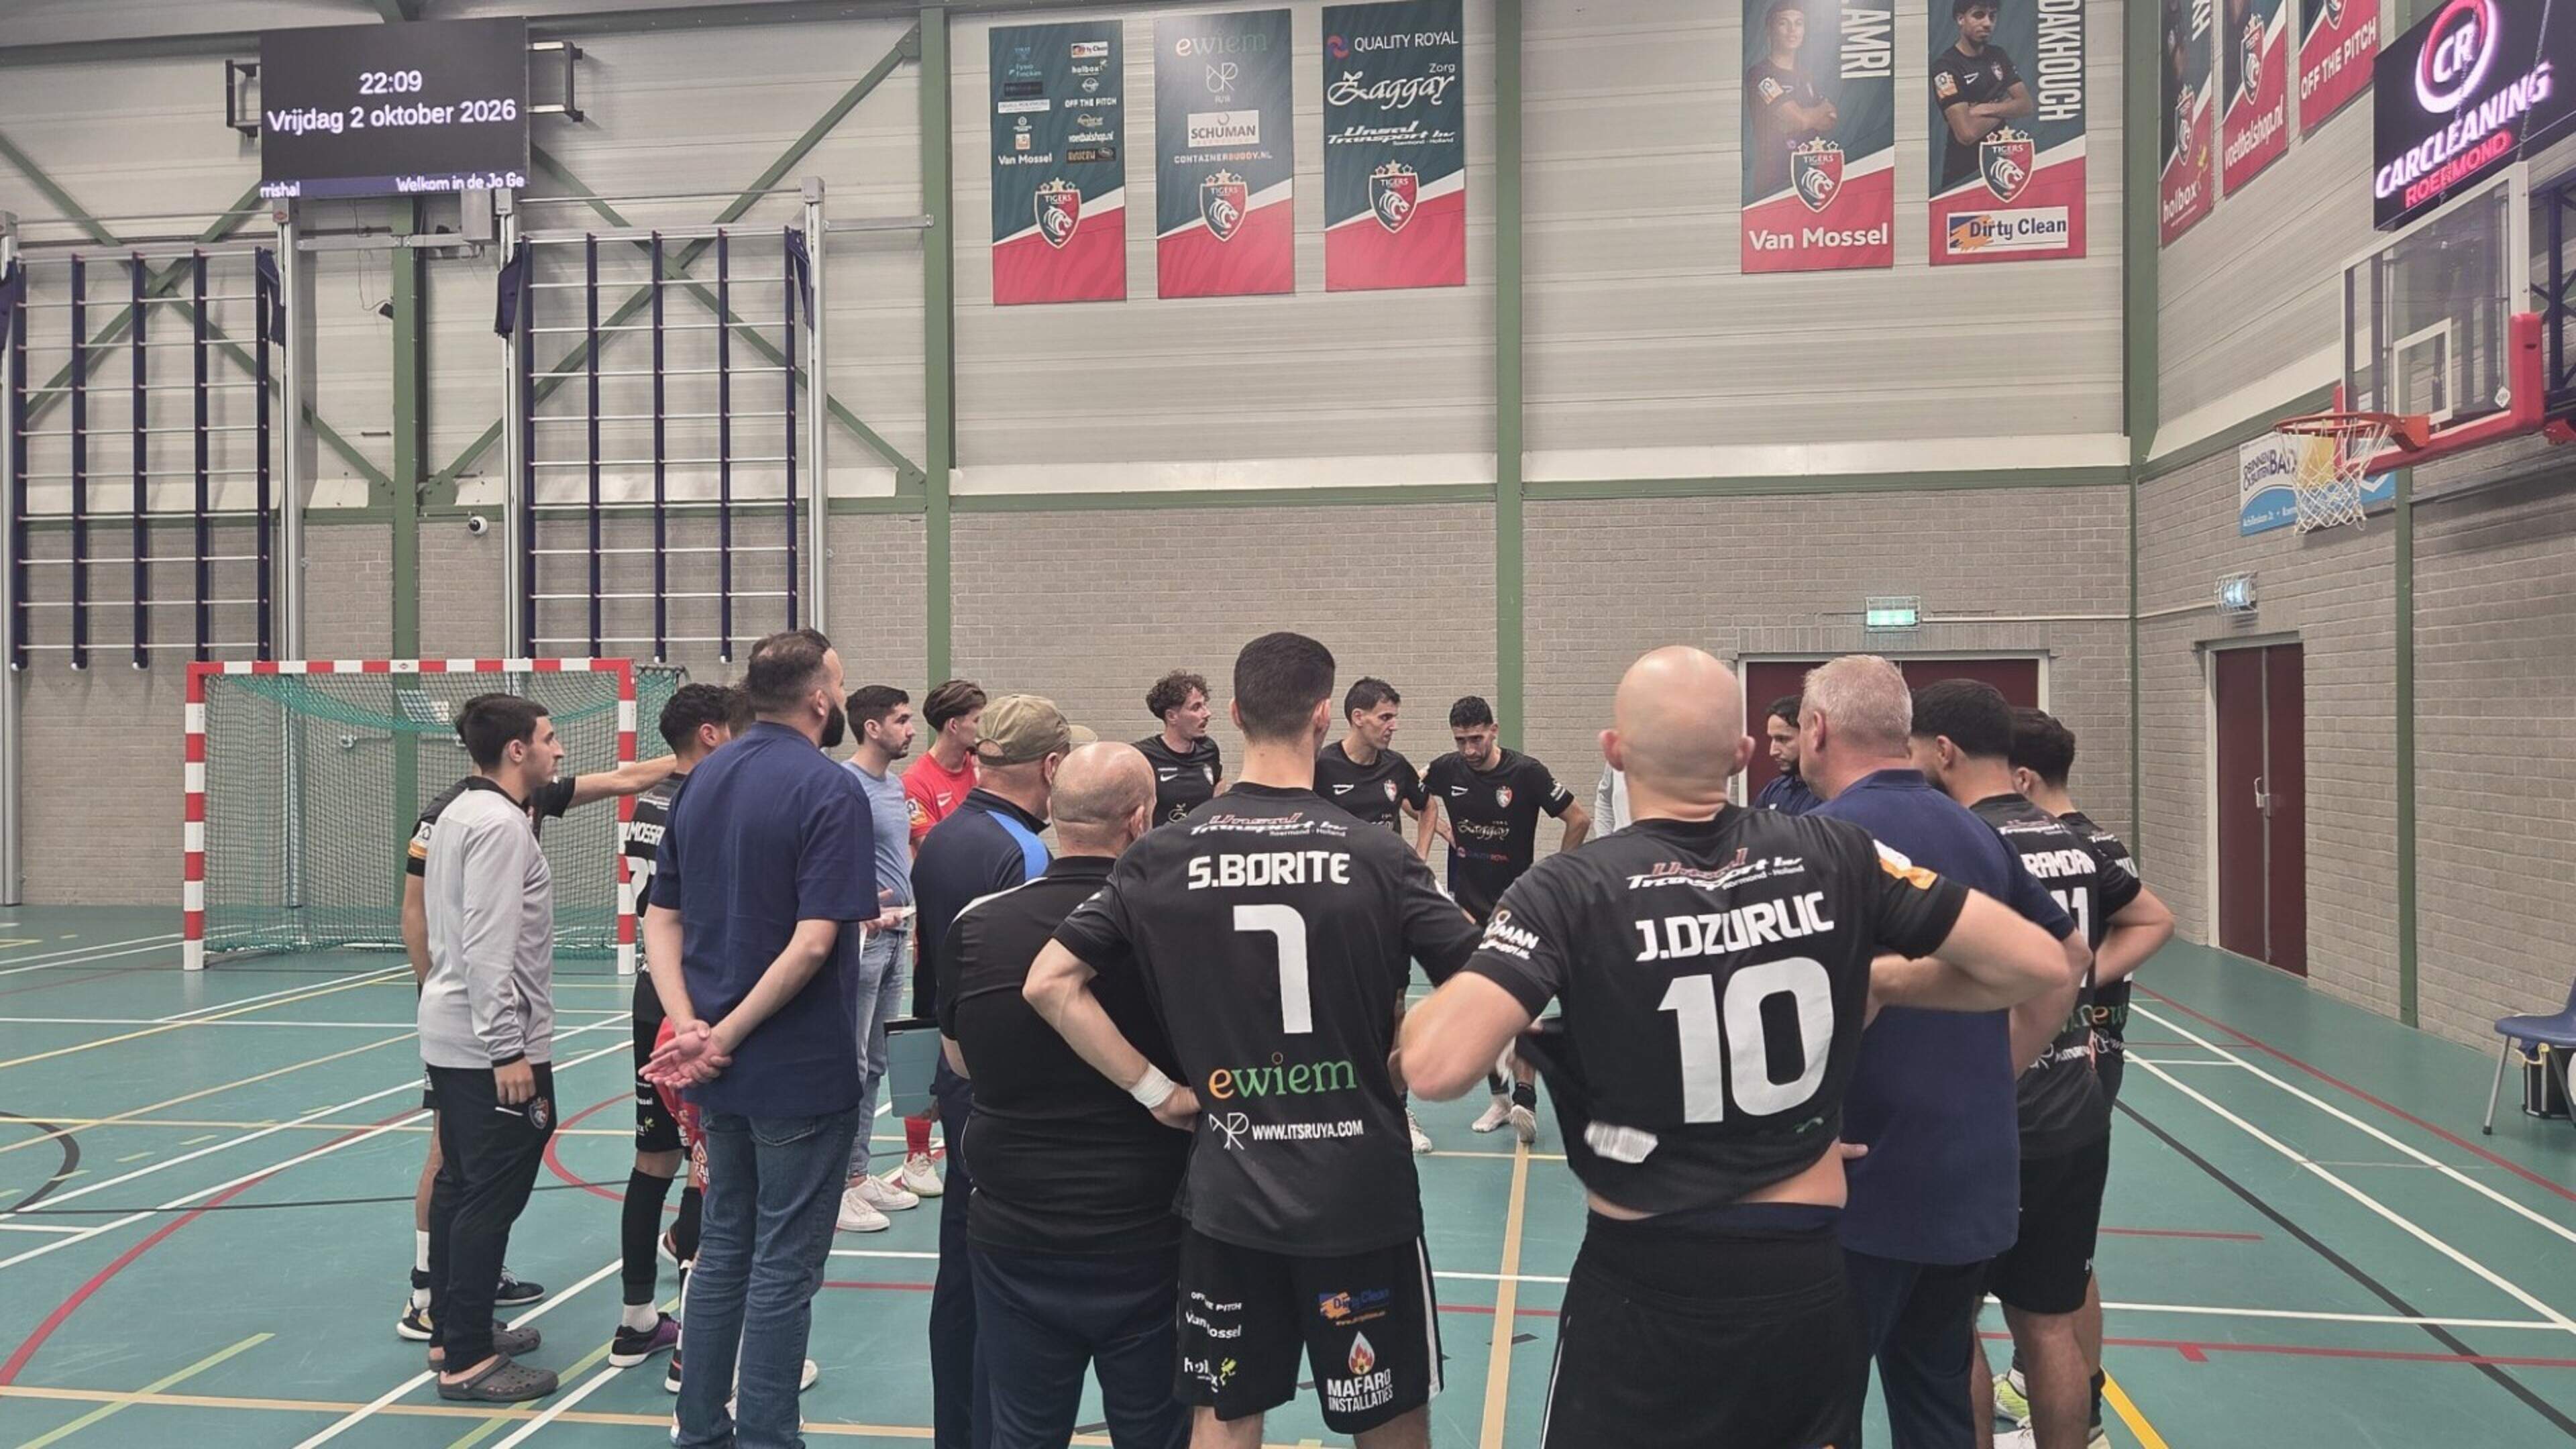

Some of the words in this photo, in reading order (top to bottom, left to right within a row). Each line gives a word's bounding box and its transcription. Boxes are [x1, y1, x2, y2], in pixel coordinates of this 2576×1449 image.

[1175, 31, 1268, 56] ewiem
[1354, 34, 1410, 52] QUALITY
[1415, 31, 1458, 47] ROYAL
[2433, 22, 2476, 83] CR
[1429, 63, 1455, 74] Zorg
[2300, 64, 2320, 100] OFF
[2322, 46, 2341, 83] THE
[2344, 17, 2377, 65] PITCH
[358, 70, 423, 95] 22:09
[1328, 70, 1455, 110] Zaggay
[1065, 99, 1078, 107] OFF
[1080, 98, 1094, 107] THE
[1096, 97, 1117, 106] PITCH
[268, 107, 344, 136] Vrijdag
[350, 107, 364, 127] 2
[370, 102, 453, 127] oktober
[460, 99, 517, 123] 2026
[1191, 125, 1256, 139] SCHUMAN
[2225, 94, 2284, 170] voetbalshop.nl
[2375, 60, 2553, 199] CARCLEANING
[998, 154, 1016, 165] Van
[1018, 152, 1053, 164] Mossel
[1803, 155, 1834, 163] TIGERS
[2404, 129, 2512, 208] ROERMOND
[396, 174, 449, 193] Welkom
[453, 175, 464, 190] in
[468, 174, 484, 189] de
[486, 172, 503, 189] Jo
[2163, 180, 2198, 224] holbox
[1748, 229, 1794, 251] Van
[1803, 222, 1888, 249] Mossel
[1970, 220, 2012, 240] Dirty
[2017, 217, 2067, 235] Clean
[1188, 850, 1351, 890] S.BORITE
[1635, 892, 1835, 962] J.DZURLIC
[1233, 904, 1313, 1034] 7
[1657, 957, 1835, 1124] 10
[1208, 1052, 1357, 1099] ewiem
[1252, 1119, 1364, 1140] WWW.ITSRUYA.COM
[1185, 1311, 1207, 1328] Van
[1207, 1324, 1242, 1339] ossel
[1328, 1383, 1393, 1413] INSTALLATIES
